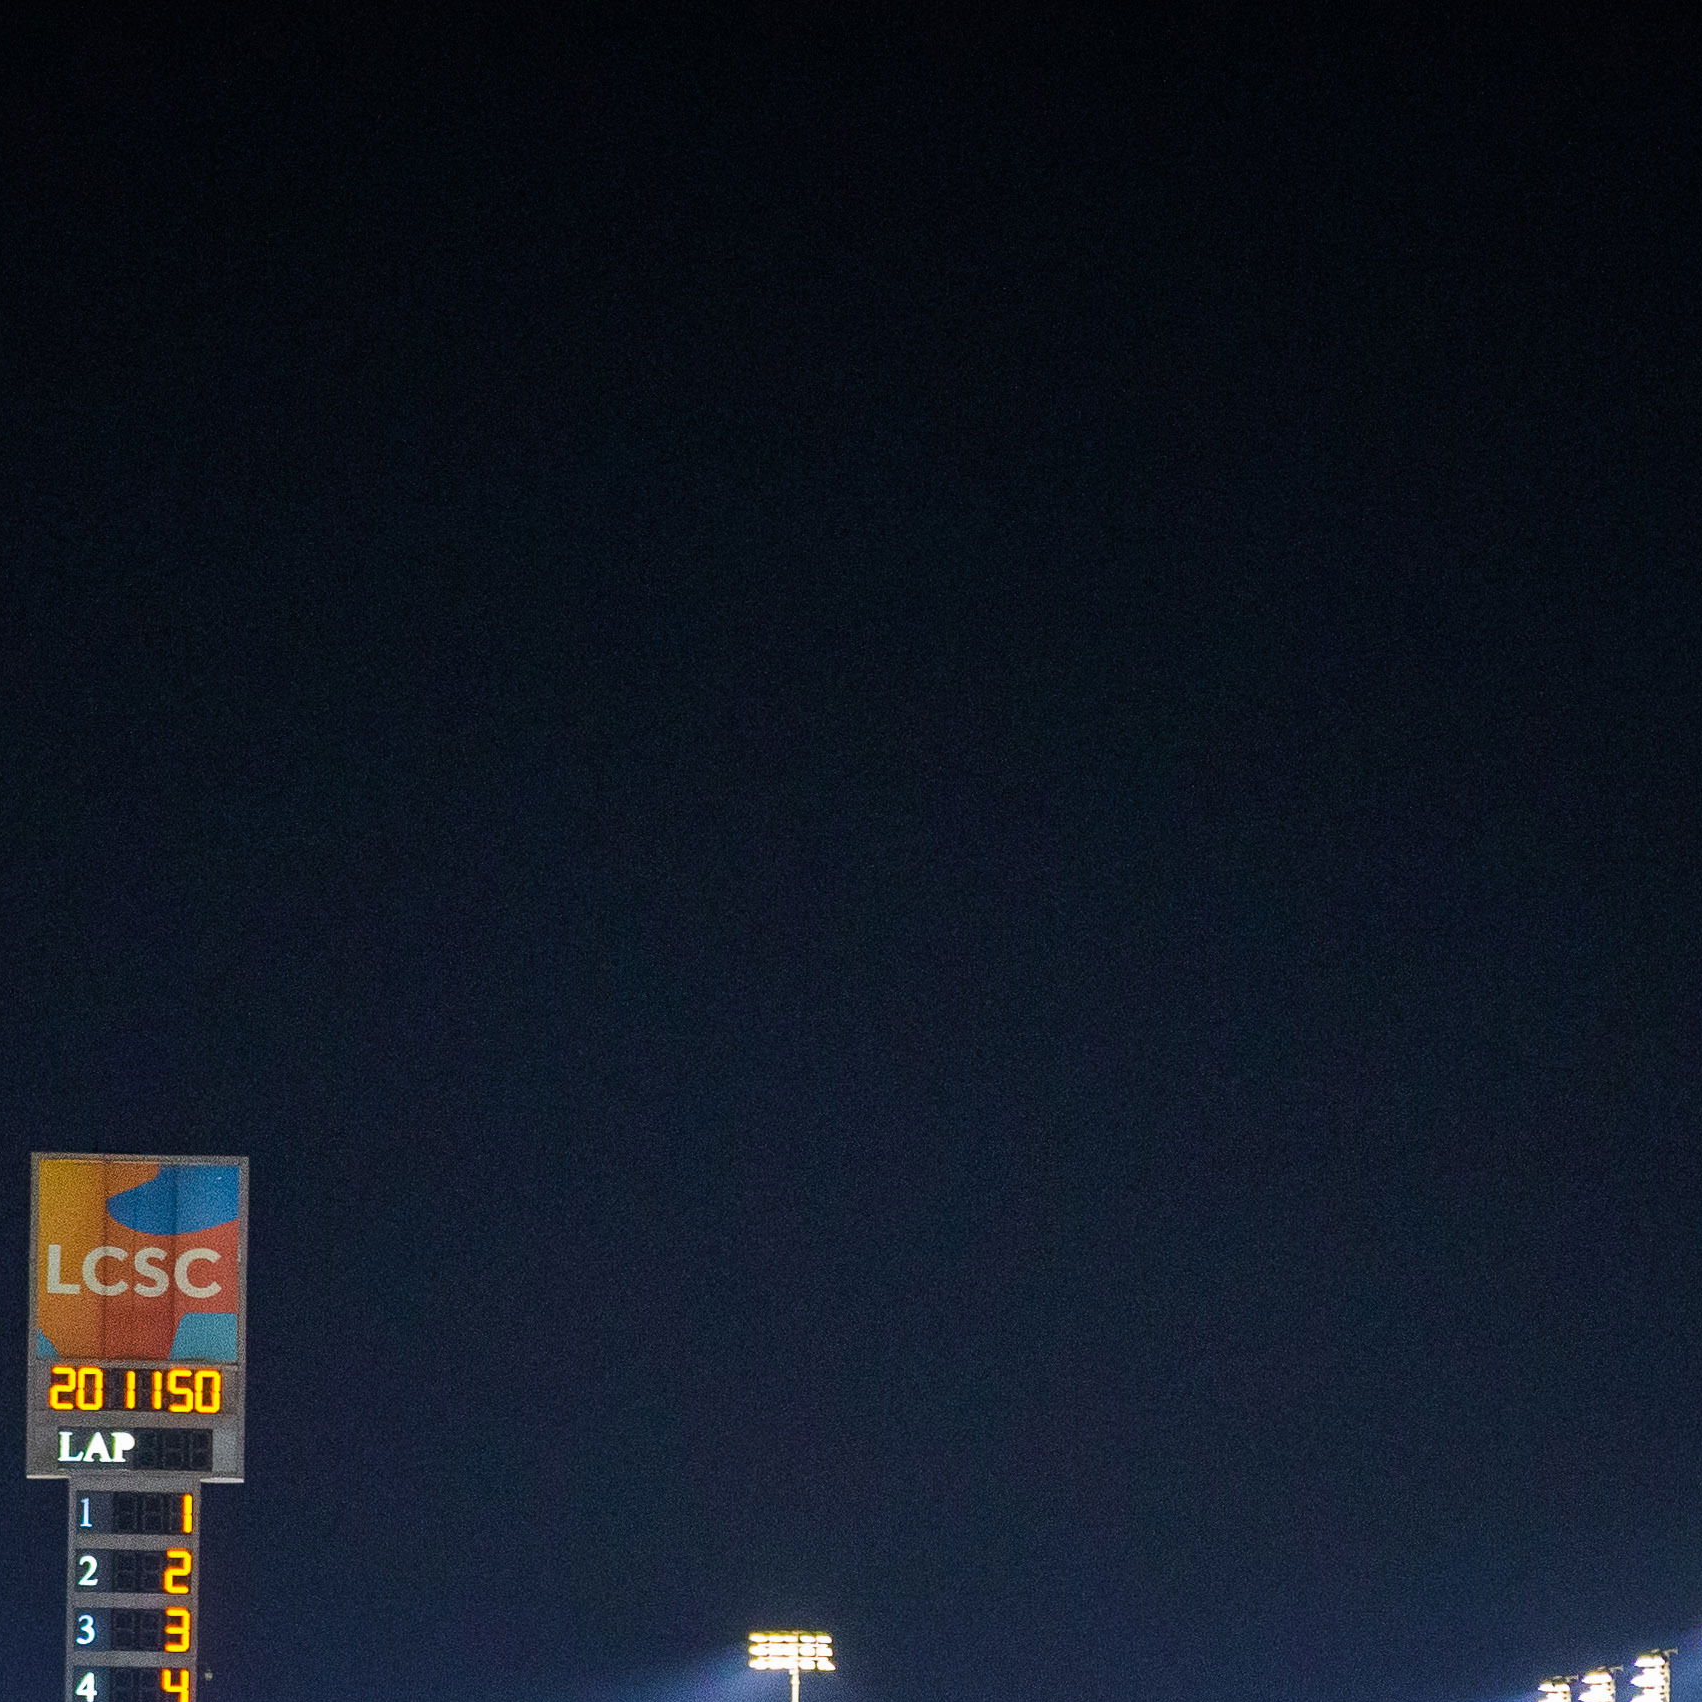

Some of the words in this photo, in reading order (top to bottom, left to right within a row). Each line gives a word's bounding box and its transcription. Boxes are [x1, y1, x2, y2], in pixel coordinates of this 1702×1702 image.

[45, 1243, 223, 1299] LCSC
[57, 1430, 136, 1464] LAP
[79, 1496, 93, 1529] 1
[180, 1493, 194, 1534] 1
[78, 1555, 99, 1587] 2
[163, 1548, 194, 1595] 2
[76, 1612, 96, 1646] 3
[163, 1606, 192, 1653] 3
